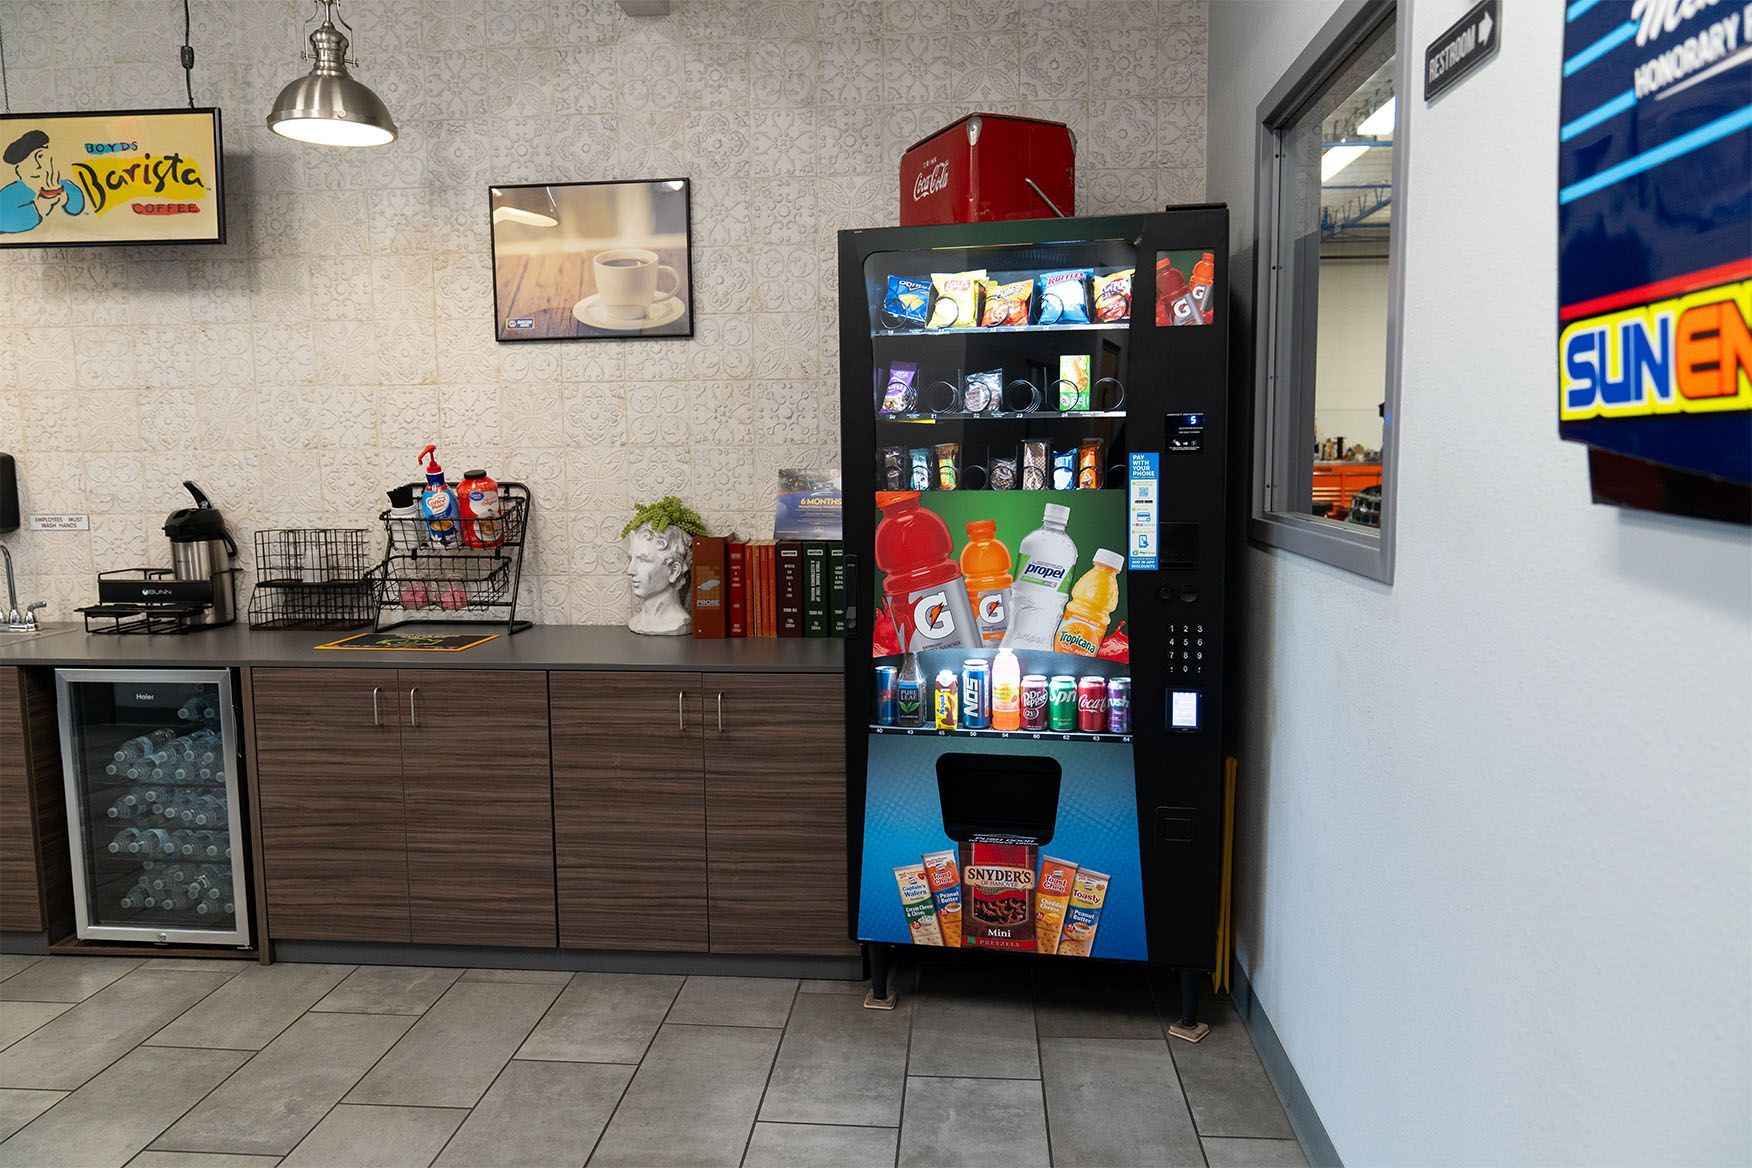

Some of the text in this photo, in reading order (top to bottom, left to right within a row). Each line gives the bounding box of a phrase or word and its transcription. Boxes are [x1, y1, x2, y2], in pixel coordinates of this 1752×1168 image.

[1428, 23, 1476, 84] RESTROOM
[1633, 11, 1741, 99] HONORARY
[87, 141, 138, 153] BOYDS
[72, 153, 204, 213] Barista
[913, 159, 949, 201] Coca-Cola
[132, 203, 196, 215] COFFEE
[1173, 298, 1192, 318] G
[800, 497, 842, 505] 6 MONTHS
[1024, 563, 1066, 579] propel
[914, 590, 956, 640] G
[979, 594, 1005, 624] G
[1060, 631, 1096, 653] Tropicana
[1169, 638, 1203, 646] 4 5 6
[1197, 652, 1202, 660] 9
[963, 678, 979, 717] NOS
[1022, 692, 1048, 708] Pepper
[1030, 690, 1041, 699] Dr
[967, 867, 1032, 884] SNYDER'S
[1045, 874, 1067, 887] Toast
[902, 884, 926, 892] Captain's
[1043, 881, 1066, 893] Chee
[903, 889, 927, 898] Wafers
[1073, 888, 1101, 904] Toasty
[1040, 903, 1060, 913] Cheese
[1041, 898, 1065, 909] Cheddar
[1072, 914, 1092, 923] Butter
[1074, 909, 1095, 919] Peanut
[987, 928, 1011, 938] Mini
